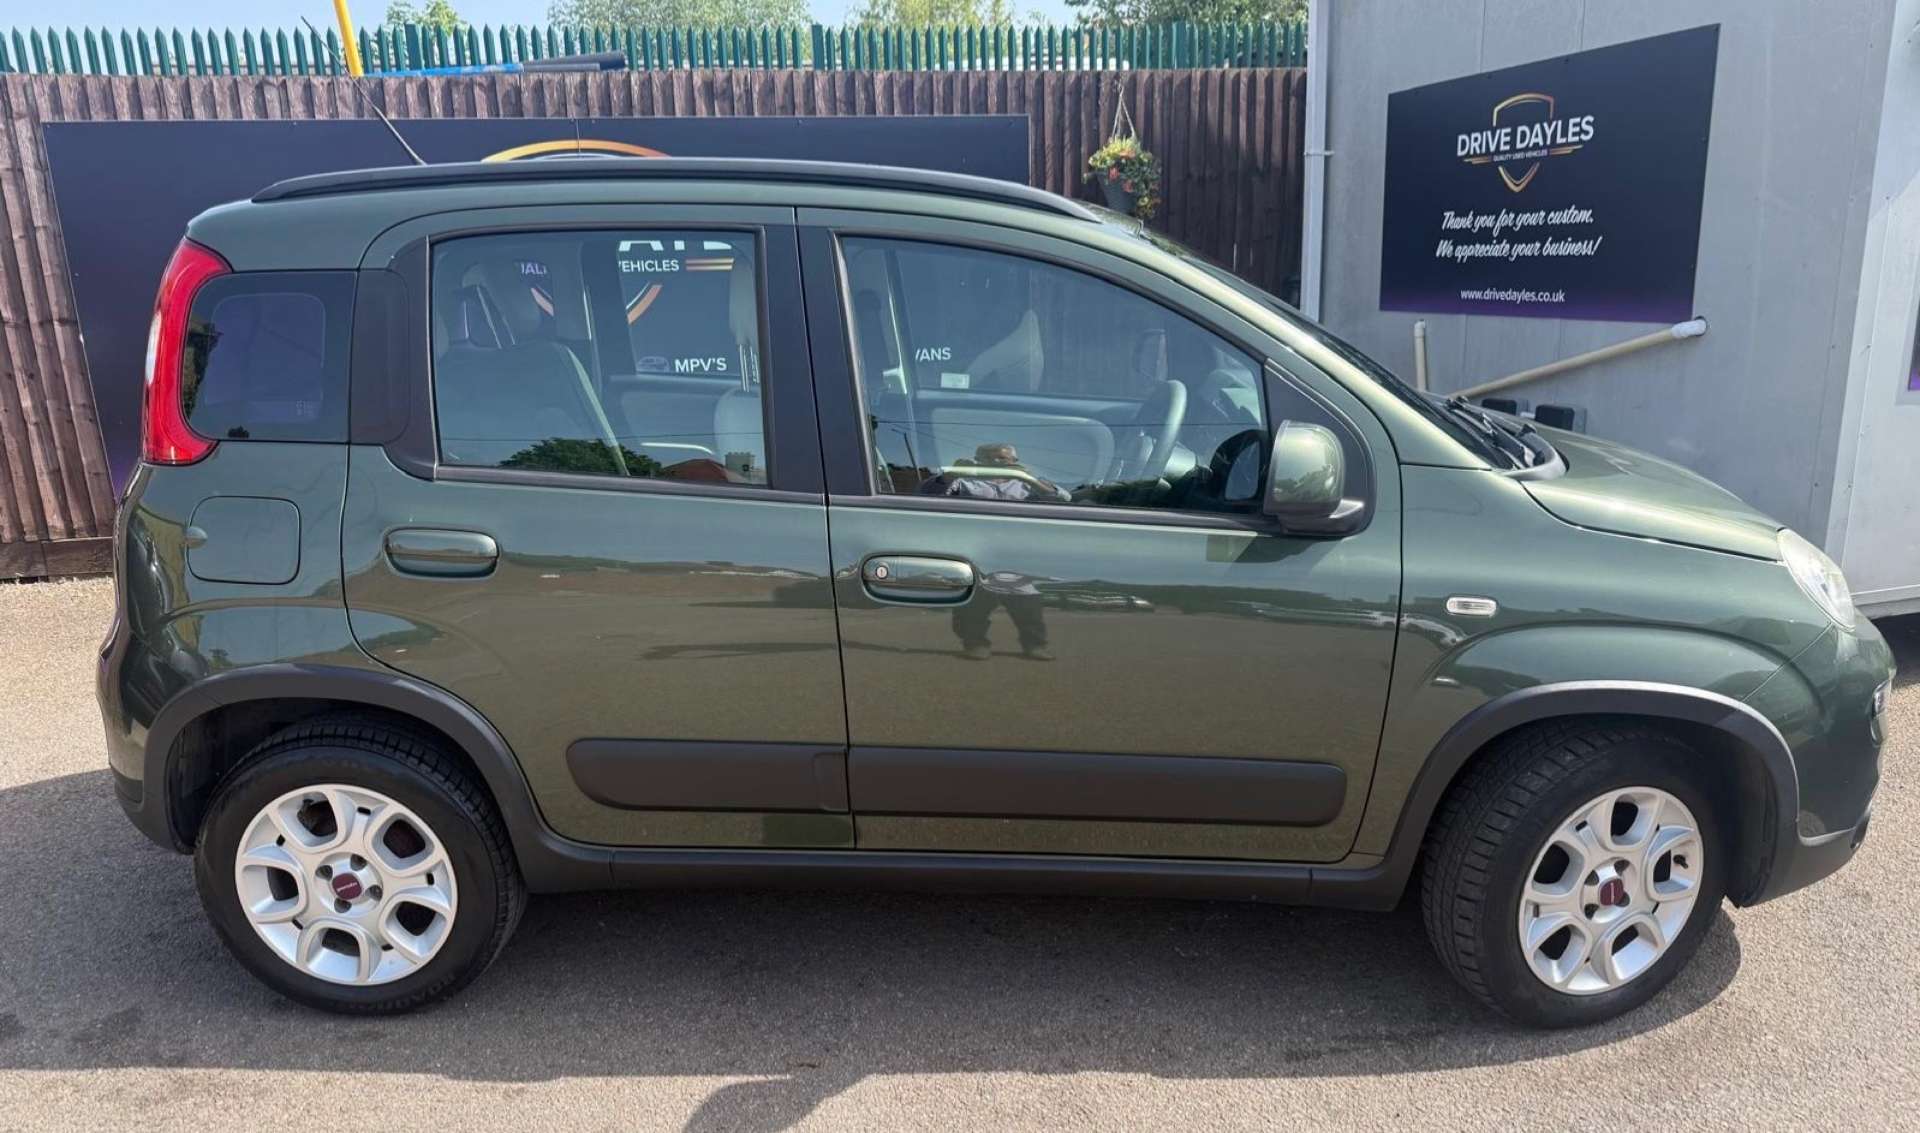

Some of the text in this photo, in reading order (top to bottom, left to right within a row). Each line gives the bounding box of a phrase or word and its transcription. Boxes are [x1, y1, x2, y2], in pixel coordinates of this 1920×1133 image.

[1457, 115, 1594, 156] DRIVE DAYLES
[1525, 150, 1548, 159] VEHICLES
[1442, 205, 1594, 237] Thank you for your custom.
[1436, 236, 1602, 263] We appreciate your business!
[618, 259, 680, 272] EHICLES
[1460, 288, 1565, 304] www.drivedayles.co.uk
